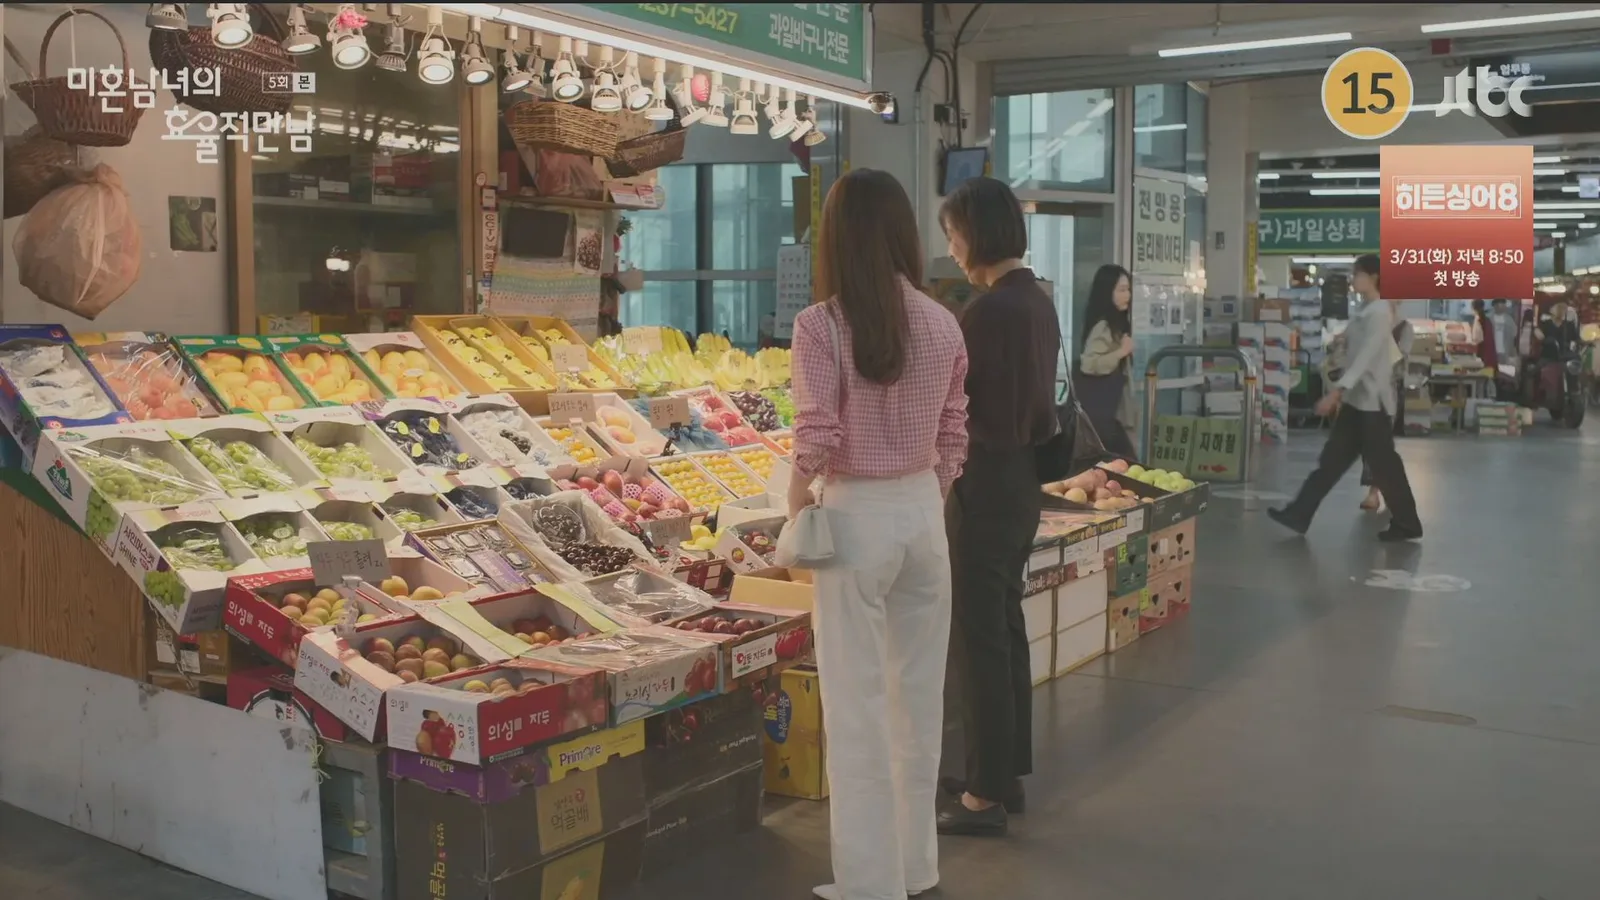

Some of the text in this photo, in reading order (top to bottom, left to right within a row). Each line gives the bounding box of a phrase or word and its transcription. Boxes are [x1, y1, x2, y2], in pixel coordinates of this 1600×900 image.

[768, 13, 849, 64] 과일바구니전문
[118, 541, 138, 568] SHINE
[258, 619, 275, 640] 자두
[529, 710, 550, 725] 자두
[429, 861, 446, 900] 먹골
